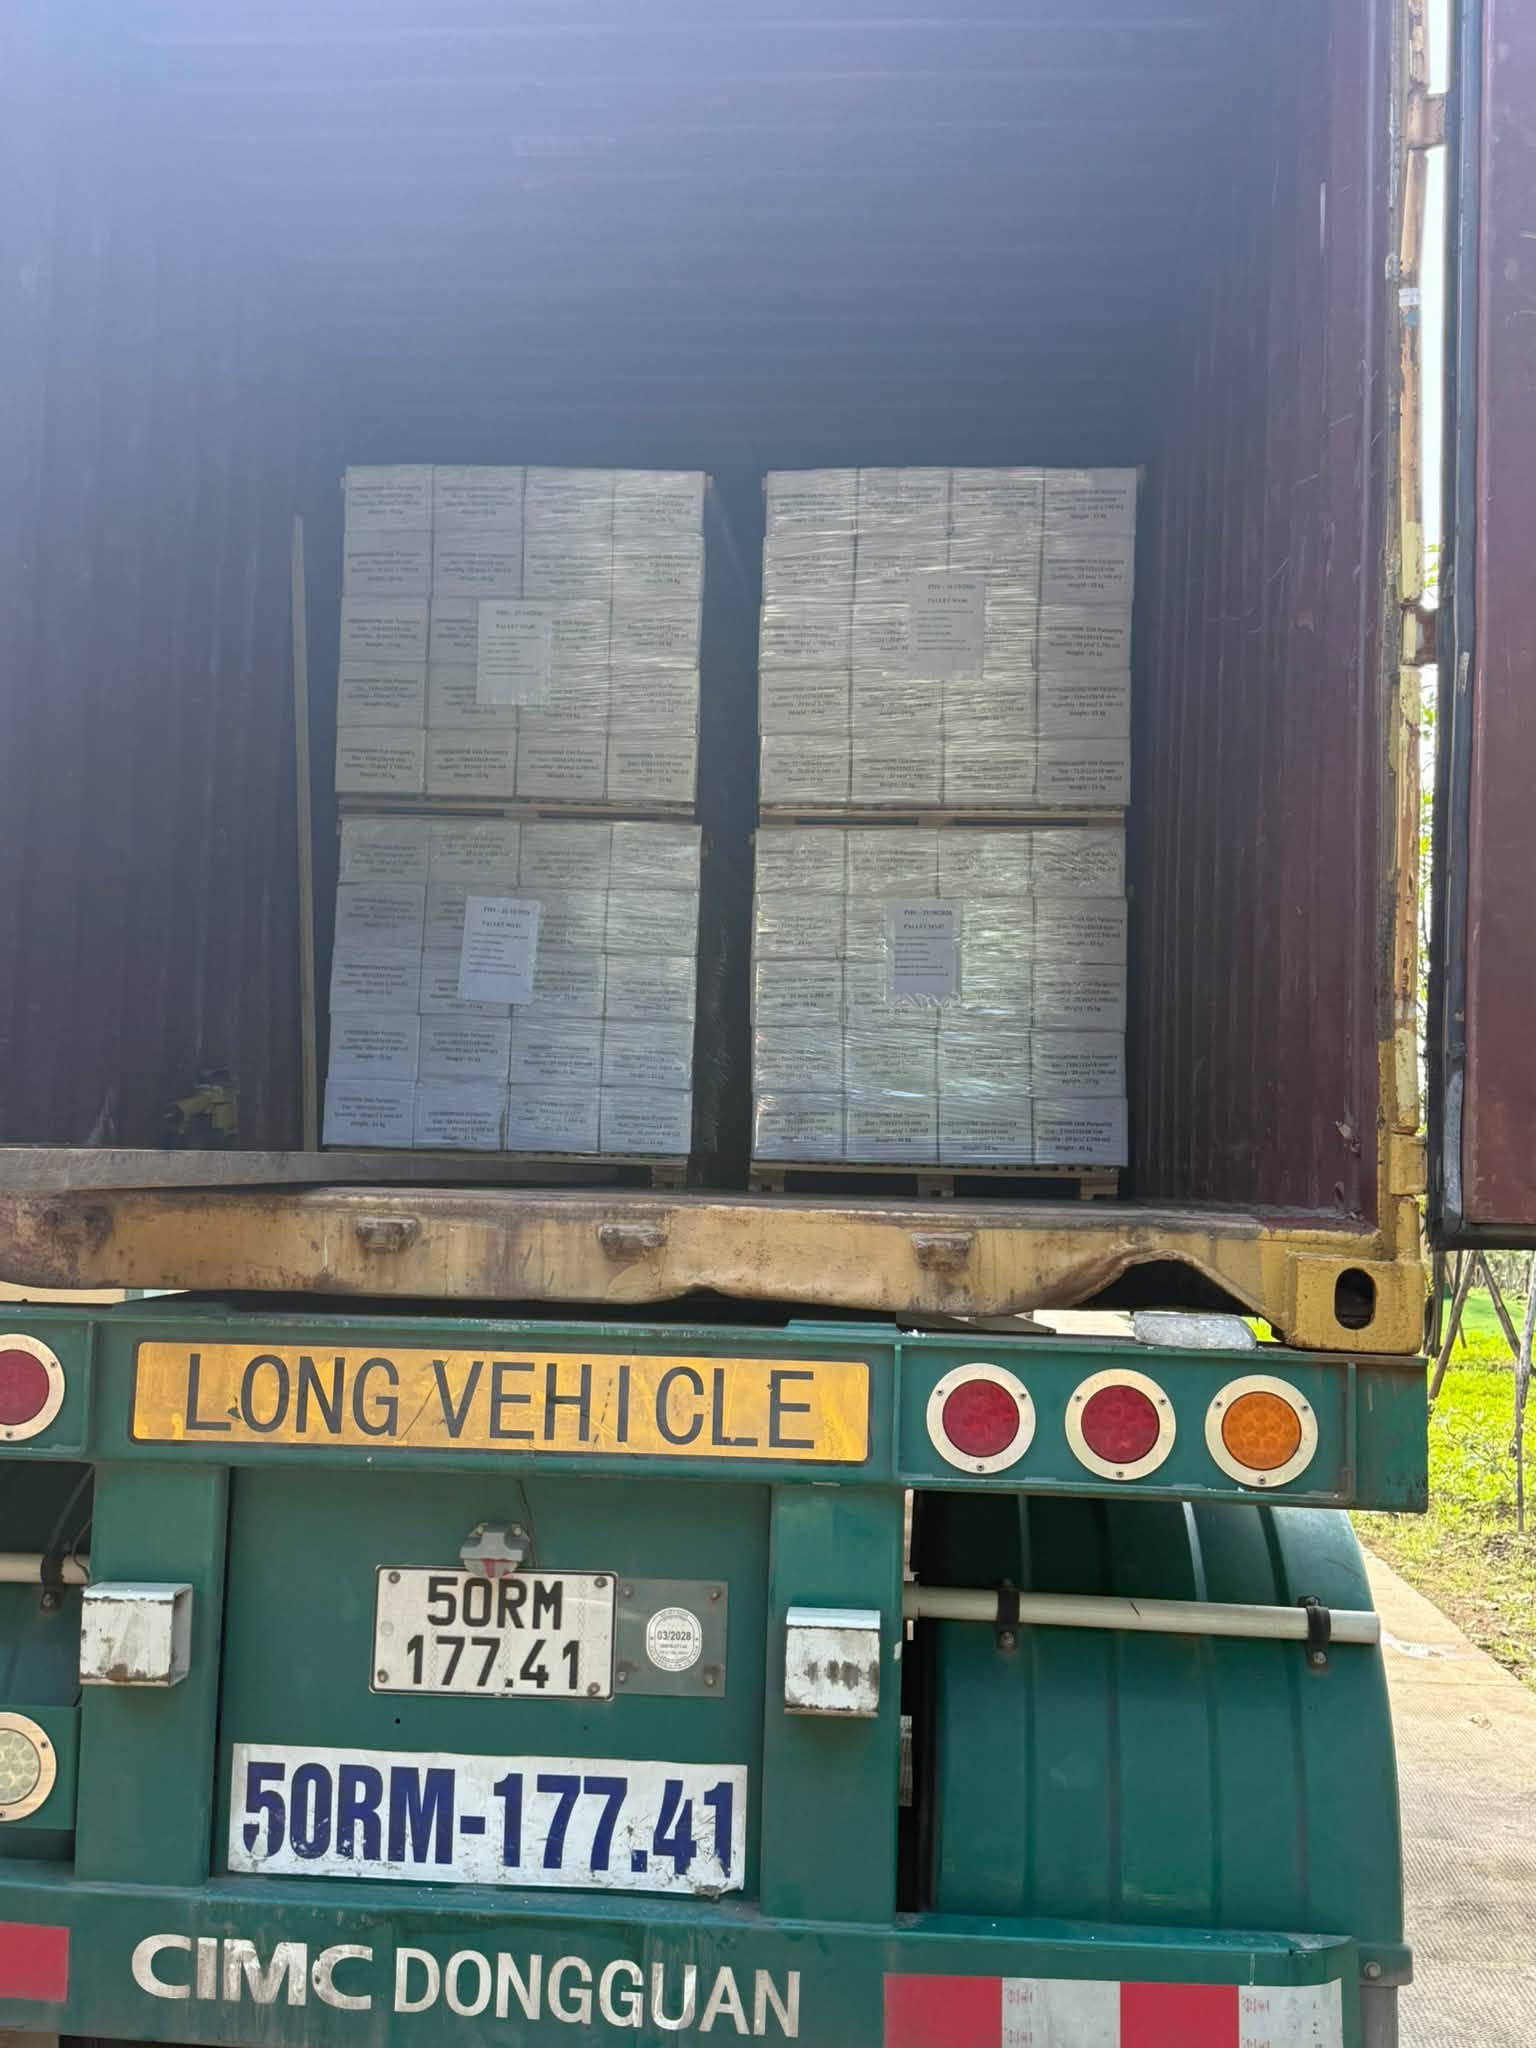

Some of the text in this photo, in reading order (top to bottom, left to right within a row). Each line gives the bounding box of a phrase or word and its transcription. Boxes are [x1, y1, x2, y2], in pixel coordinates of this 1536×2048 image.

[186, 1353, 815, 1450] LONG VEHICLE
[427, 1576, 563, 1630] 50RM
[656, 1630, 692, 1641] 03/2028
[407, 1634, 580, 1689] 177.41
[242, 1761, 734, 1879] 50RM-177.41
[131, 1933, 801, 2039] CIMC DONGGUAN
